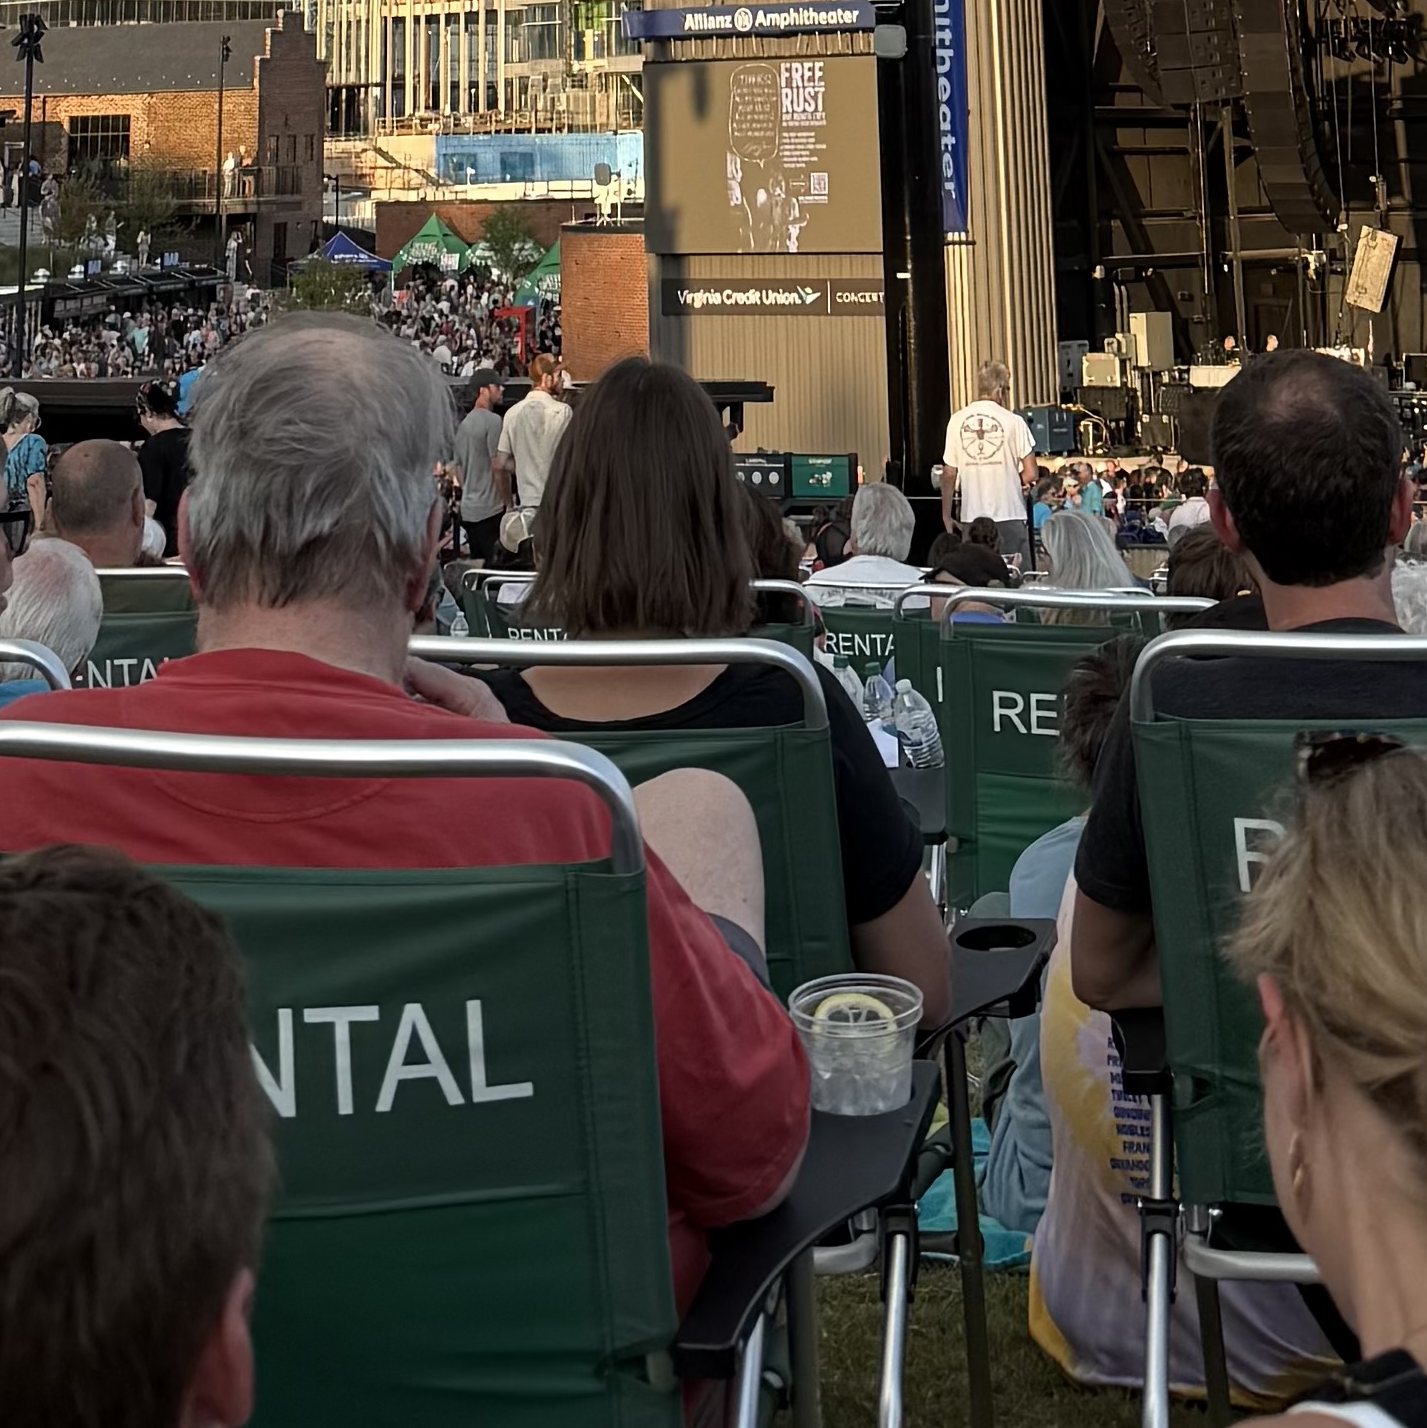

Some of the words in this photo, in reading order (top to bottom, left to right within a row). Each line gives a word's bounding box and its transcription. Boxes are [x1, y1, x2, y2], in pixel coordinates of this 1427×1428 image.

[684, 12, 733, 31] Allianz
[754, 7, 860, 30] Amphitheater
[780, 61, 826, 88] FREE
[781, 87, 826, 113] RUST
[677, 288, 722, 309] Virginia
[722, 288, 760, 305] Credit
[507, 627, 568, 641] RENT
[823, 632, 894, 656] RENTA
[249, 999, 534, 1118] NTAL
